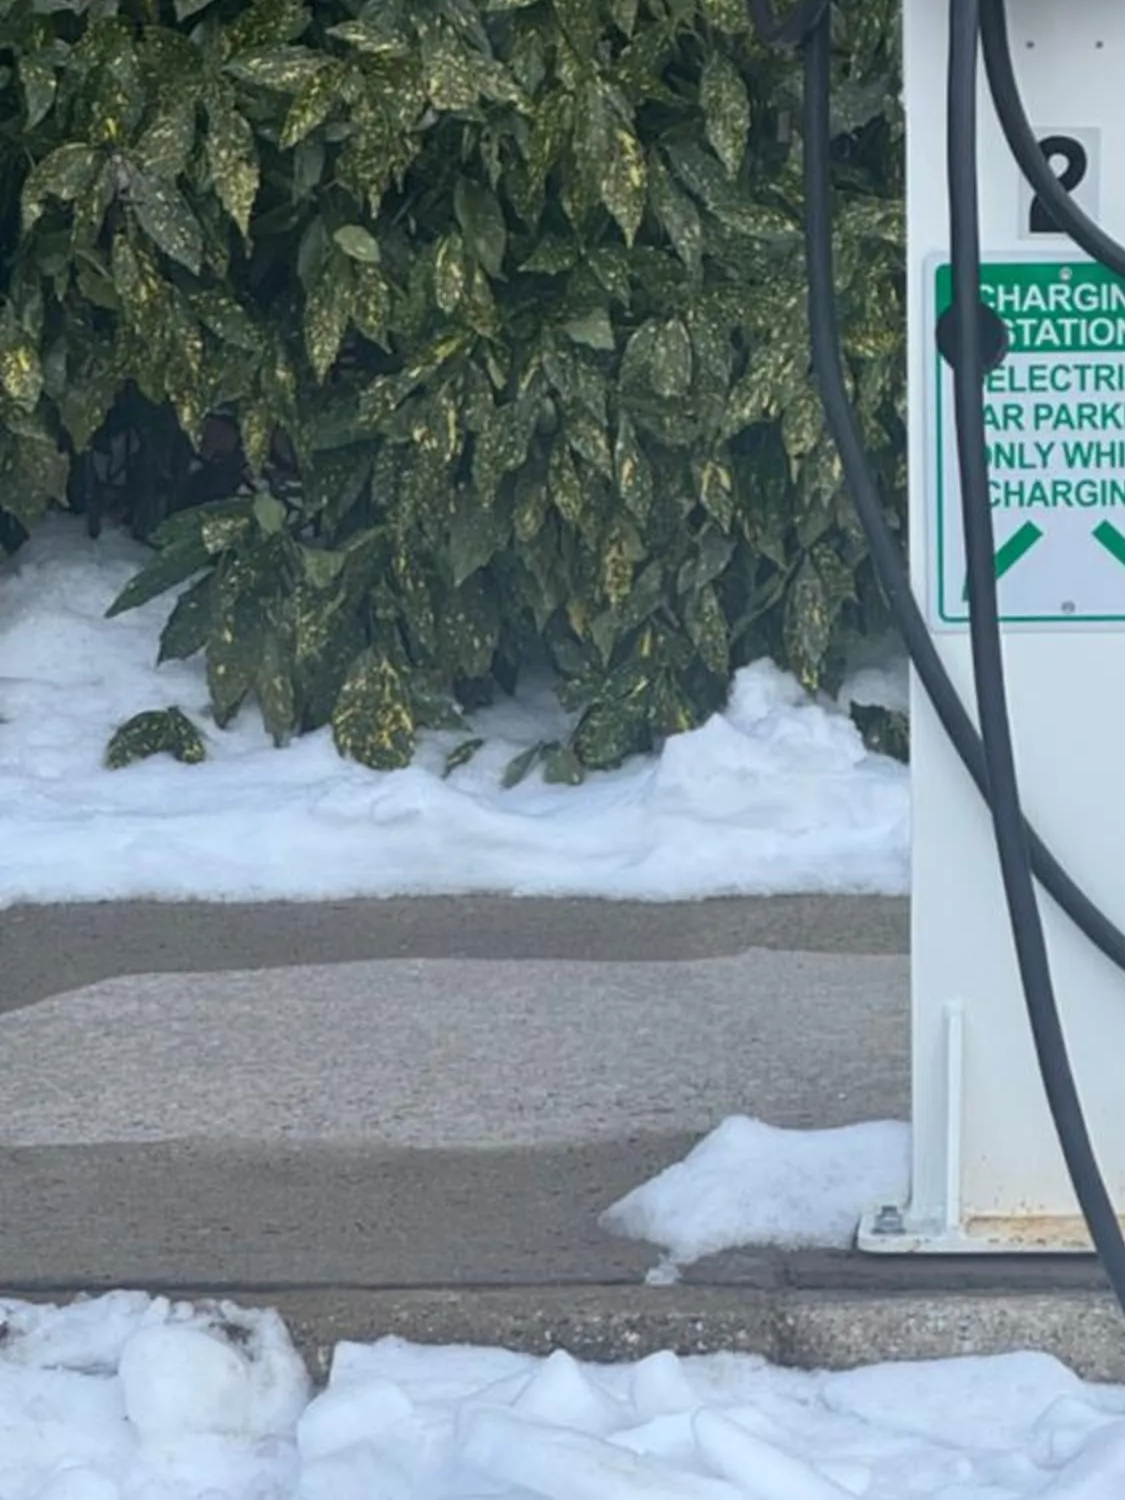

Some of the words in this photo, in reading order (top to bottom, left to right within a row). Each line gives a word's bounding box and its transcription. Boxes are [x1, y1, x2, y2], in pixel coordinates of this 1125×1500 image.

[1029, 135, 1088, 233] 2
[982, 403, 1024, 431] AR
[983, 441, 1056, 470] NLY
